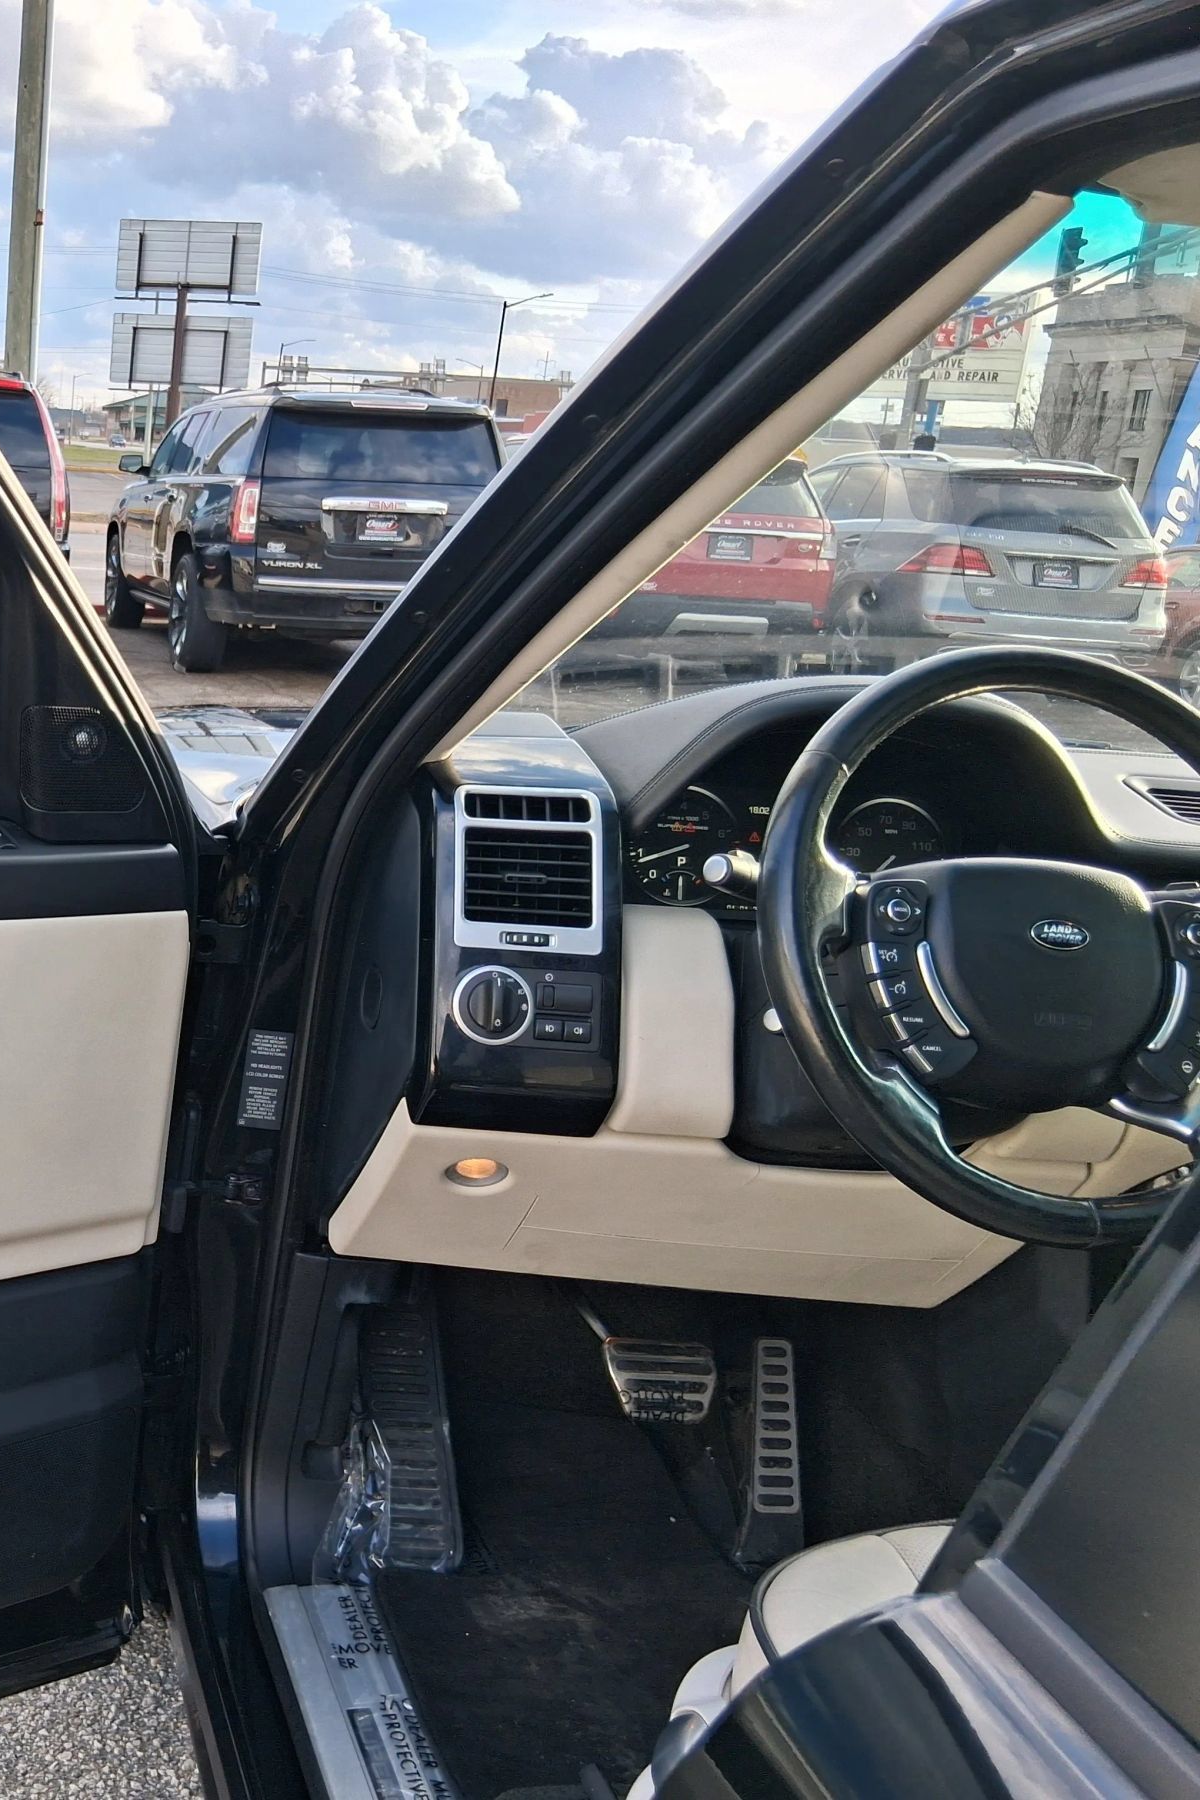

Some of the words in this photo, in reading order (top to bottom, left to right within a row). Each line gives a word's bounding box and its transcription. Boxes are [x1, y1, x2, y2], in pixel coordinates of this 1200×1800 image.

[957, 371, 999, 382] REPAIR
[743, 519, 795, 529] ROVER
[262, 560, 304, 569] YUKON
[305, 562, 323, 570] XL
[677, 857, 687, 867] P
[1043, 924, 1072, 934] LAND
[1047, 933, 1083, 945] ROVER
[338, 1594, 368, 1641] DEALER
[404, 1715, 439, 1768] DEALER
